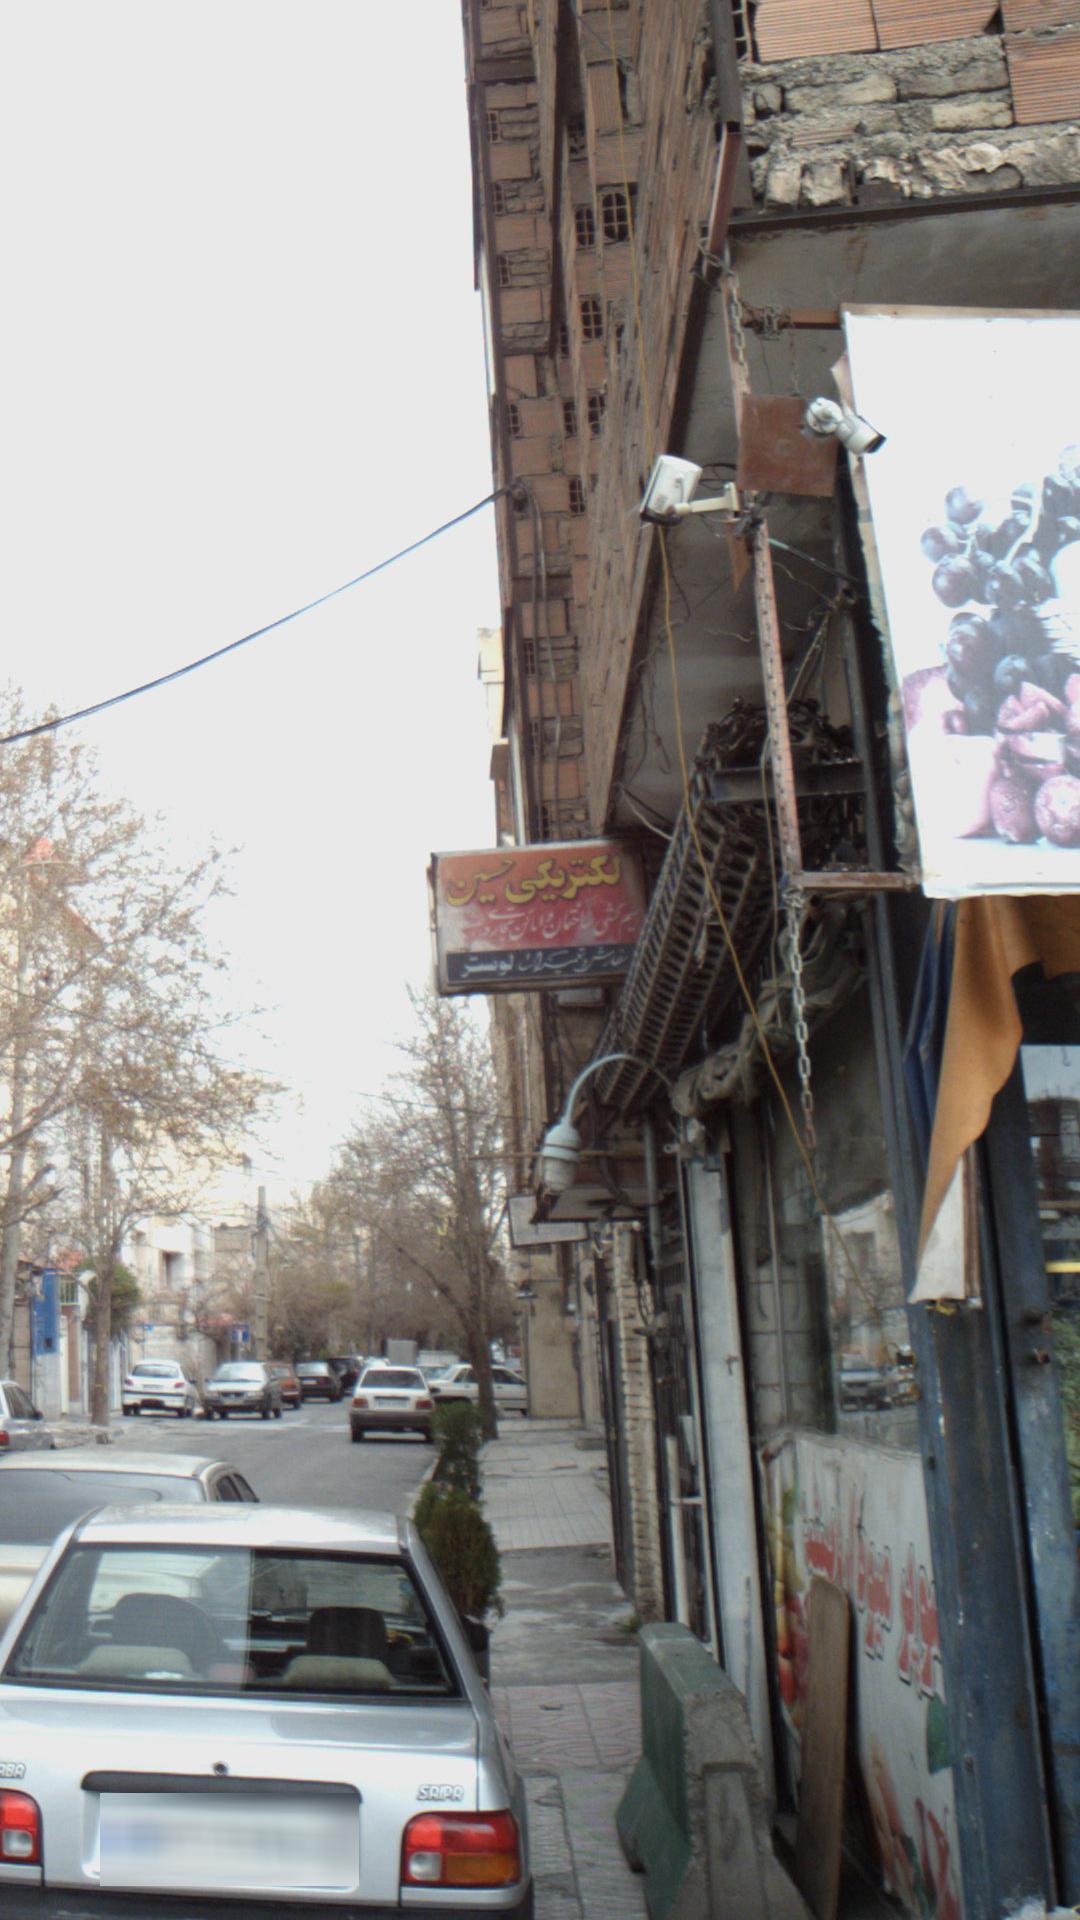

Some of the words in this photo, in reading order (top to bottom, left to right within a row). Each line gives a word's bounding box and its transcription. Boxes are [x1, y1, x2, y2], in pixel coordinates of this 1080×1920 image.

[447, 858, 516, 907] حسین
[505, 854, 621, 904] لکتریکی
[416, 1784, 464, 1801] SAIPA
